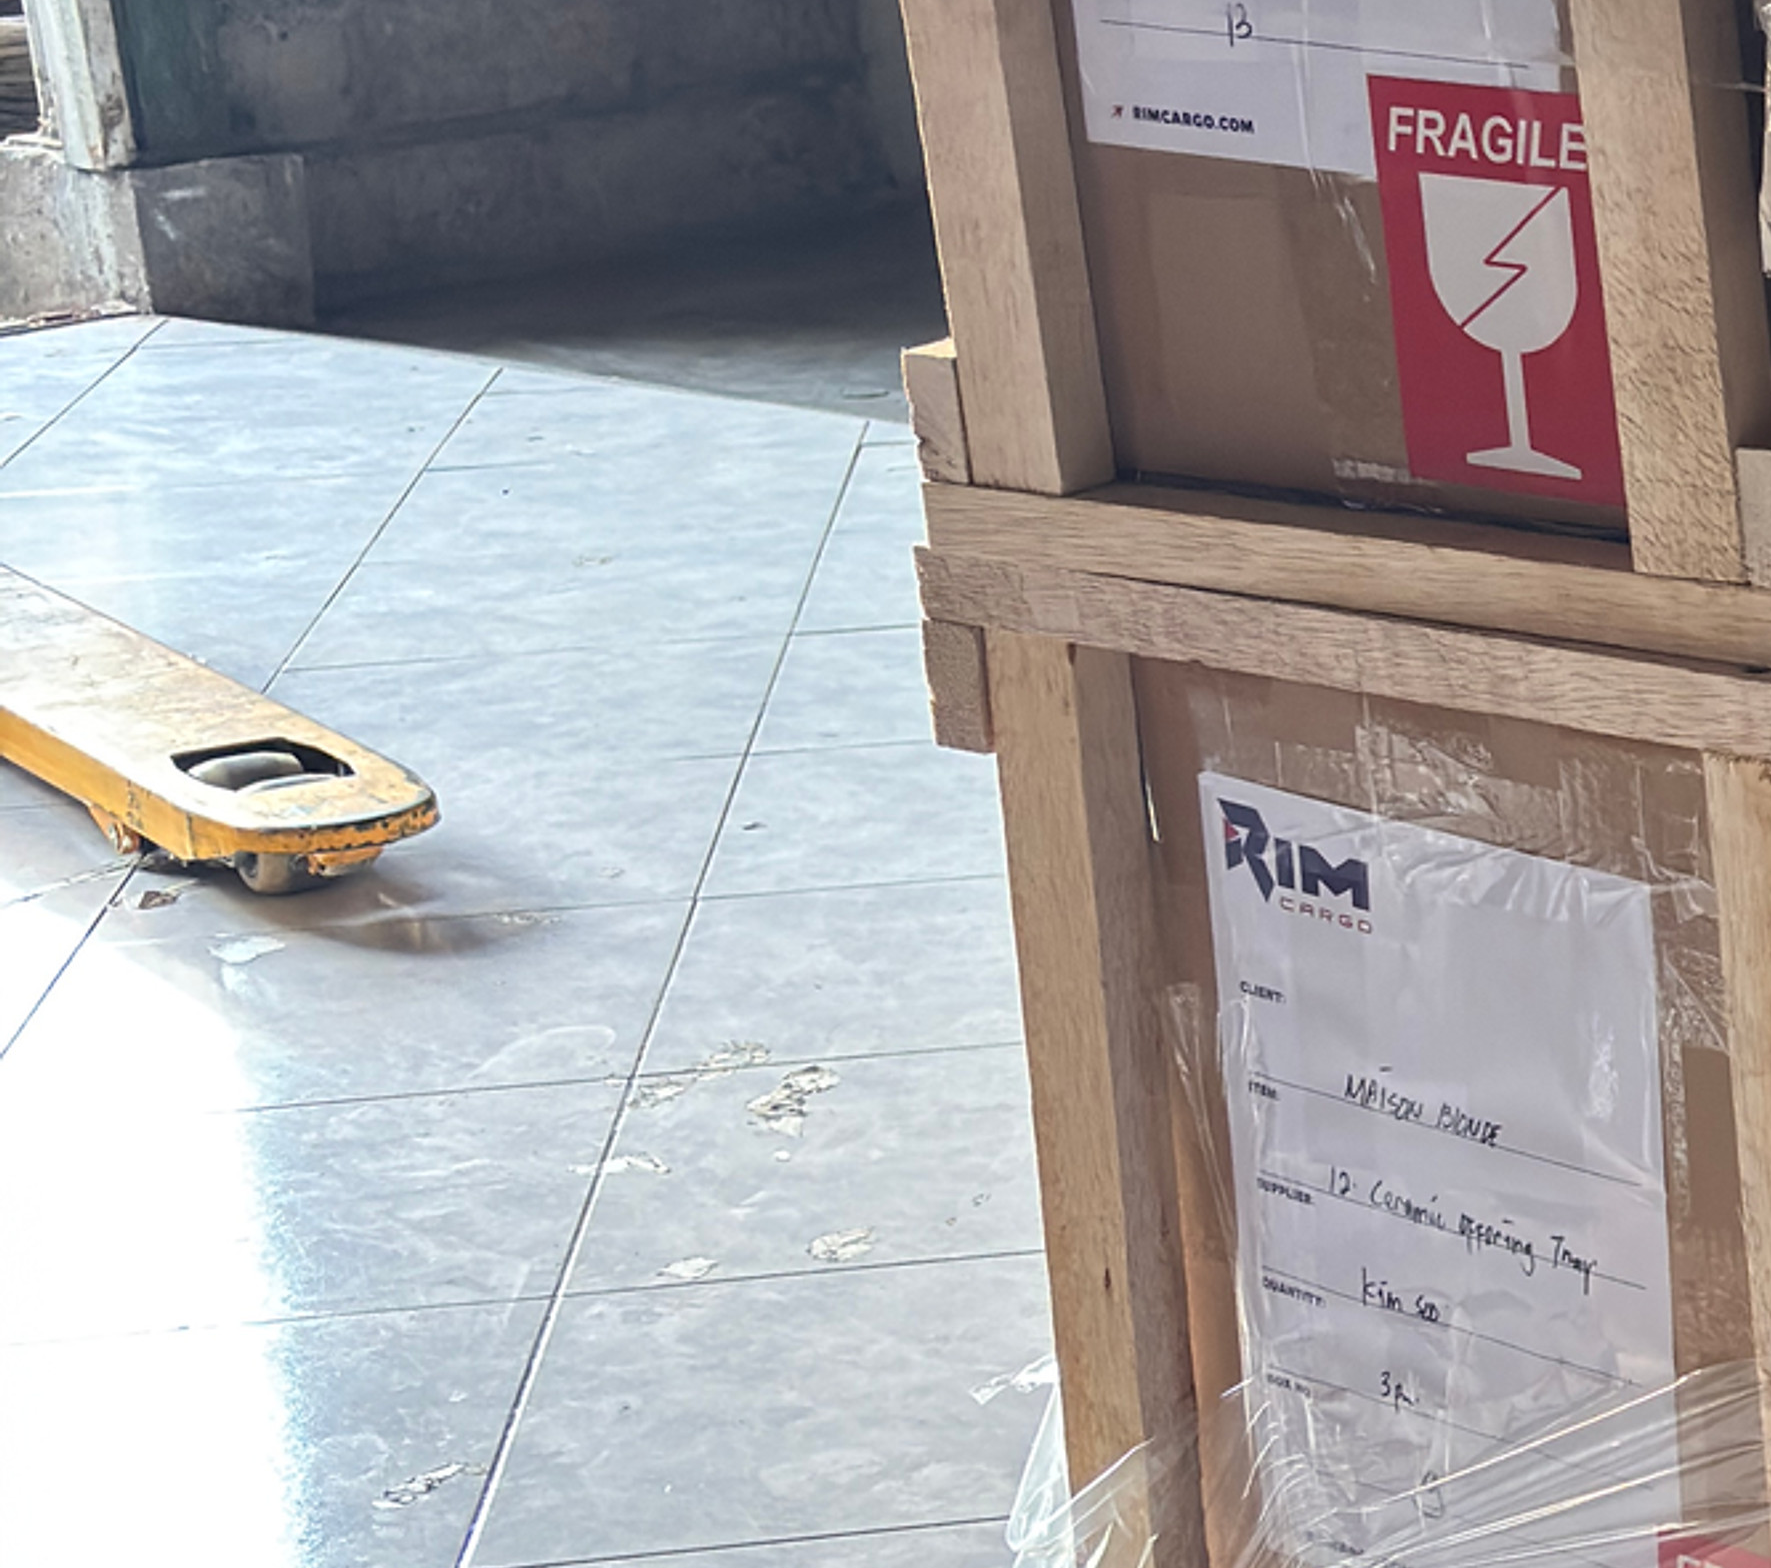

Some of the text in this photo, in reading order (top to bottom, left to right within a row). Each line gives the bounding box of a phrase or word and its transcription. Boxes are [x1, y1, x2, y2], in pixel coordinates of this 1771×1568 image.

[1132, 105, 1255, 136] RIMCARGO.COM
[1386, 106, 1588, 171] FRAGILE
[1217, 797, 1371, 912] RIM
[1280, 895, 1373, 934] CARGO
